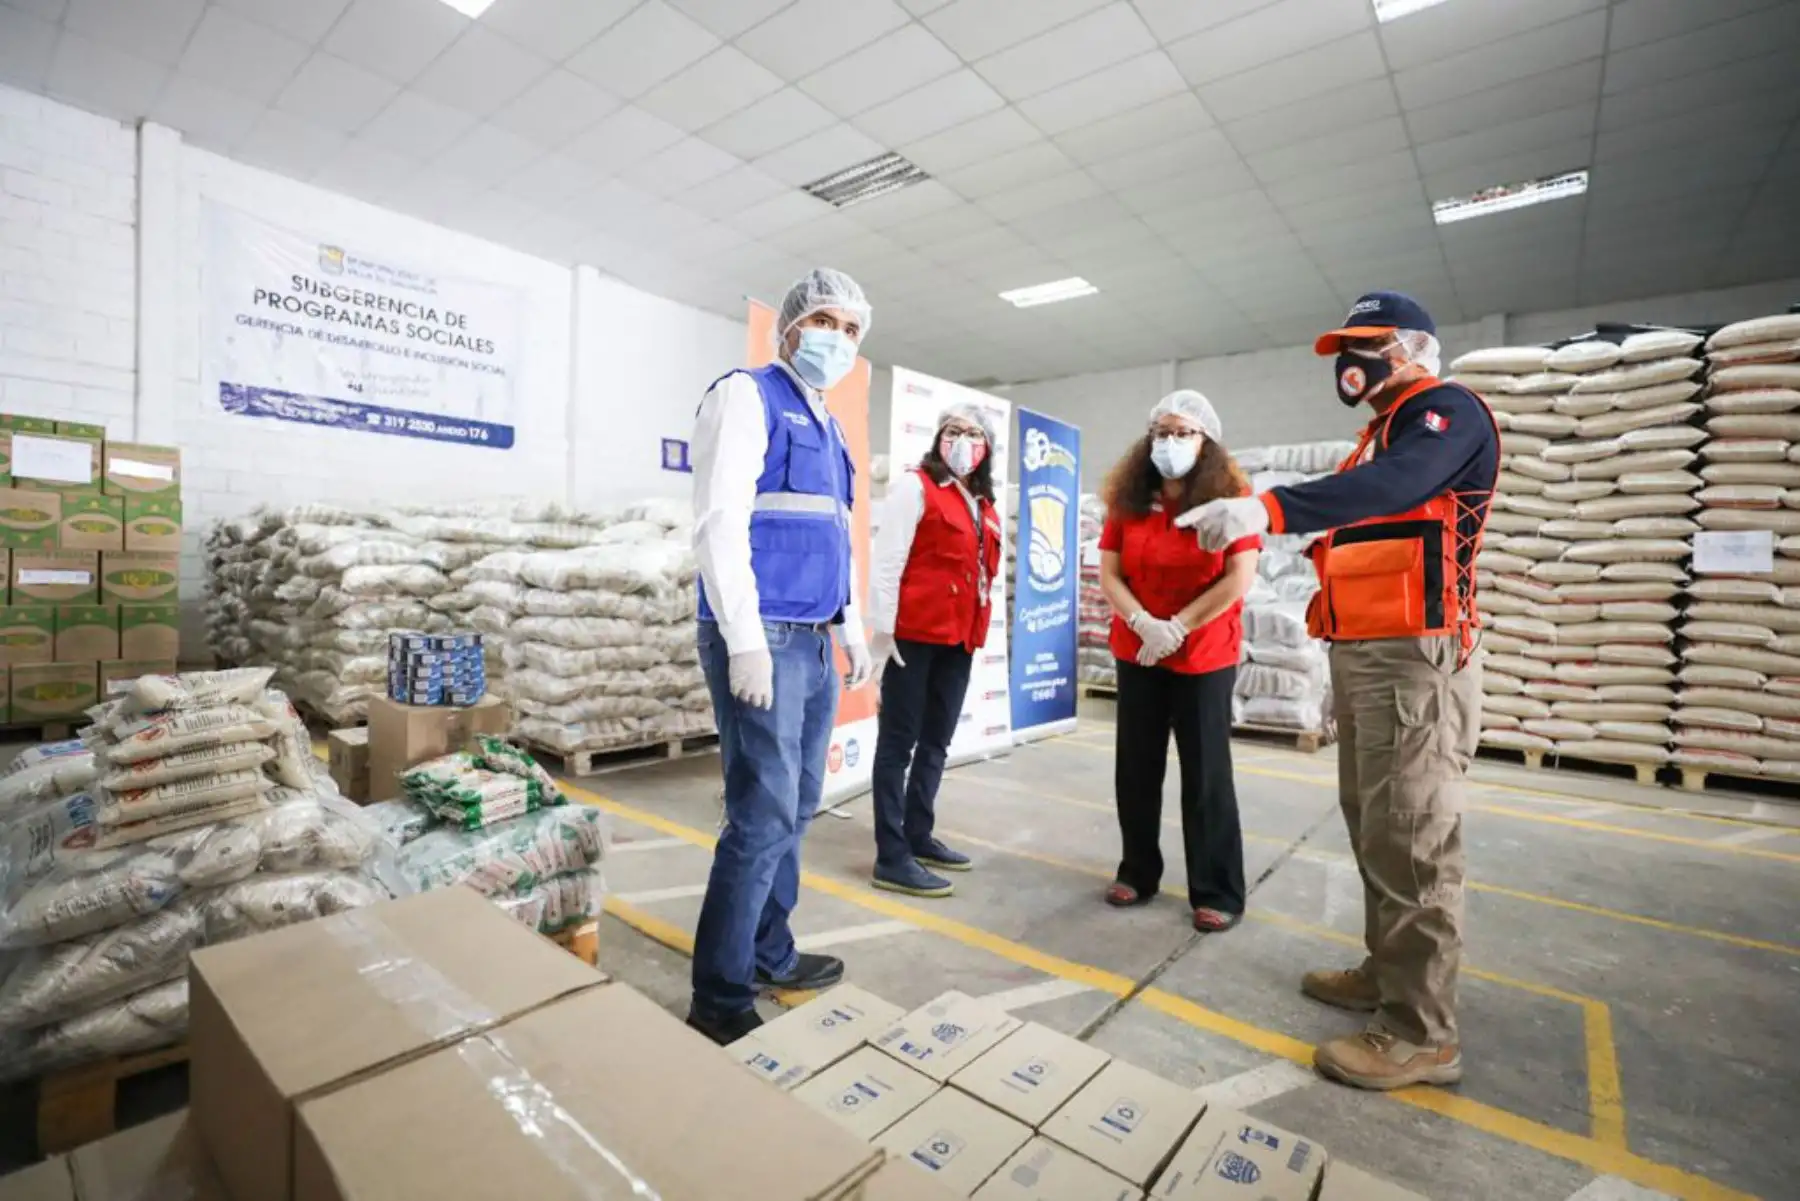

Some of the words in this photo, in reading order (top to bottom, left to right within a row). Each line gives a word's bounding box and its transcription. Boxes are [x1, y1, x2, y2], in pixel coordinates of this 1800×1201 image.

[253, 288, 400, 335] PROGRAMAS
[406, 322, 495, 355] SOCIALES
[291, 274, 439, 324] SUBGERENCIA
[444, 311, 468, 330] DE
[468, 427, 489, 441] 176
